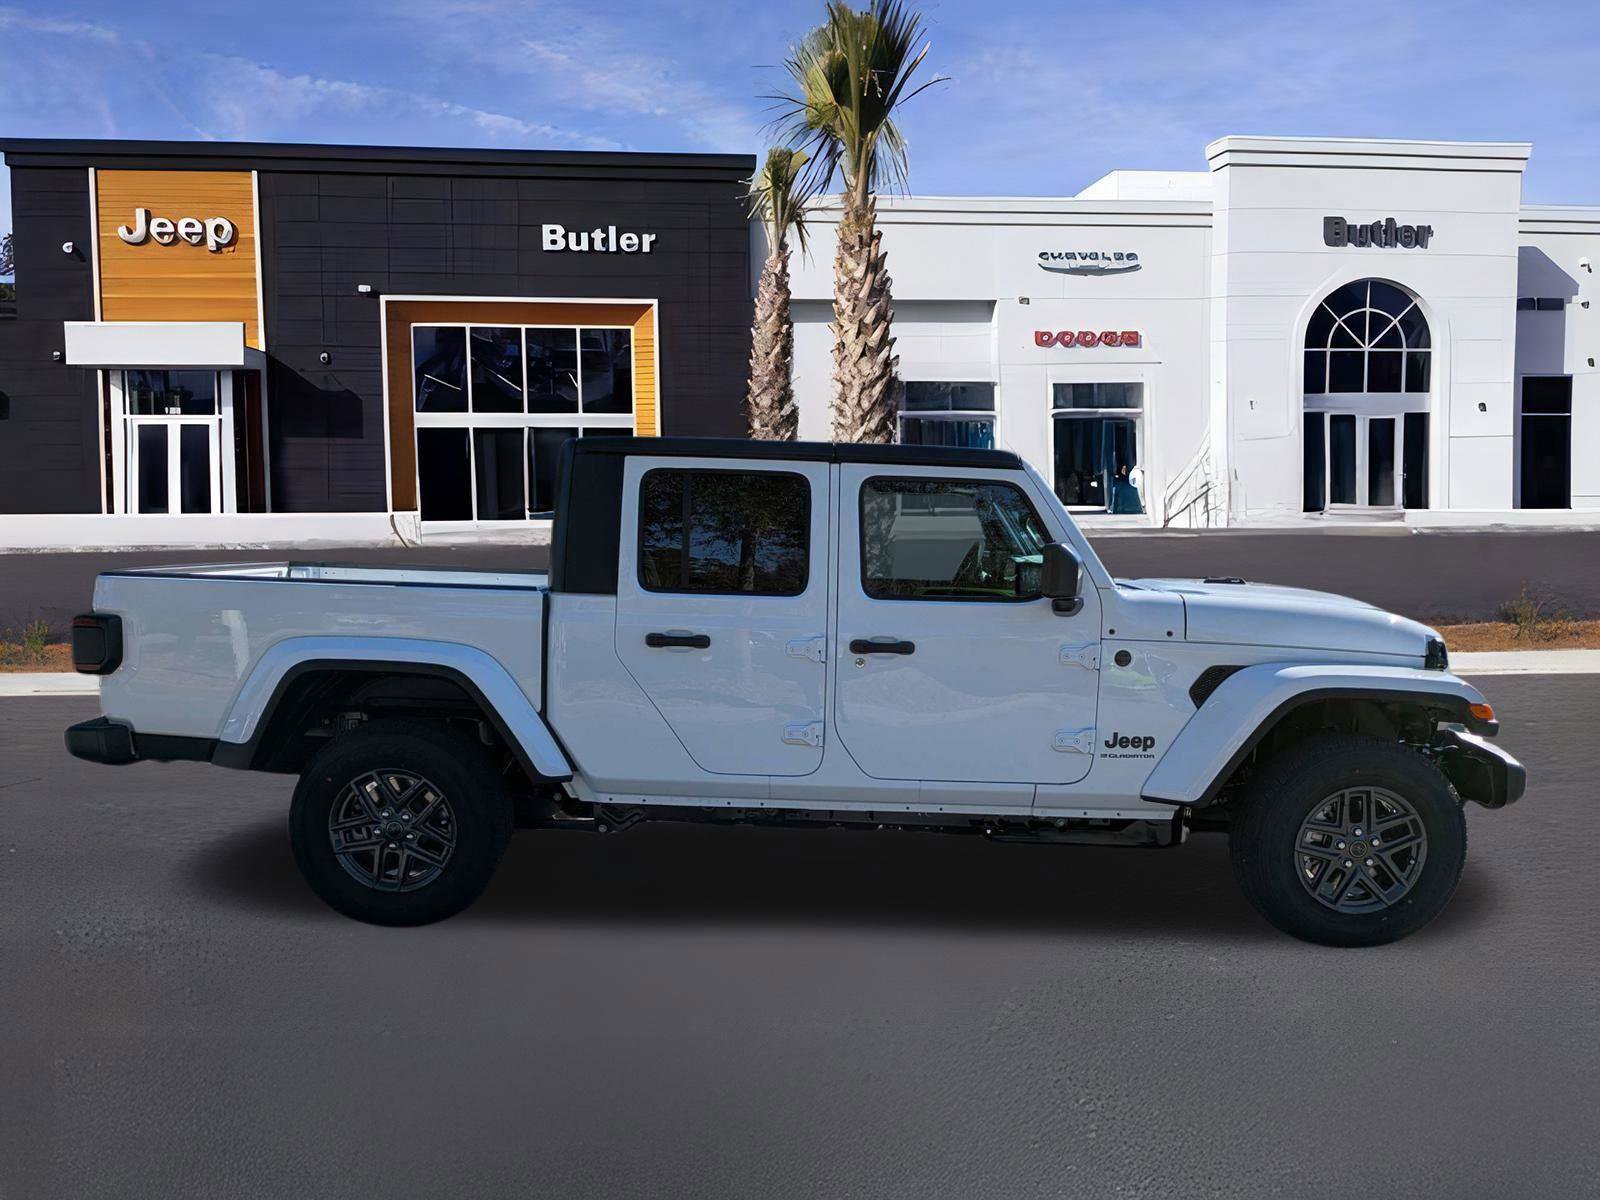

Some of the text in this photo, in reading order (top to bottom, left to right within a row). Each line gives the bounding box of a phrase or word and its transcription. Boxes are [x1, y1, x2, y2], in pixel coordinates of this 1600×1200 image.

[117, 207, 235, 251] Jeep
[541, 223, 657, 253] Butler
[1323, 216, 1434, 249] Butler
[1104, 732, 1156, 752] Jeep
